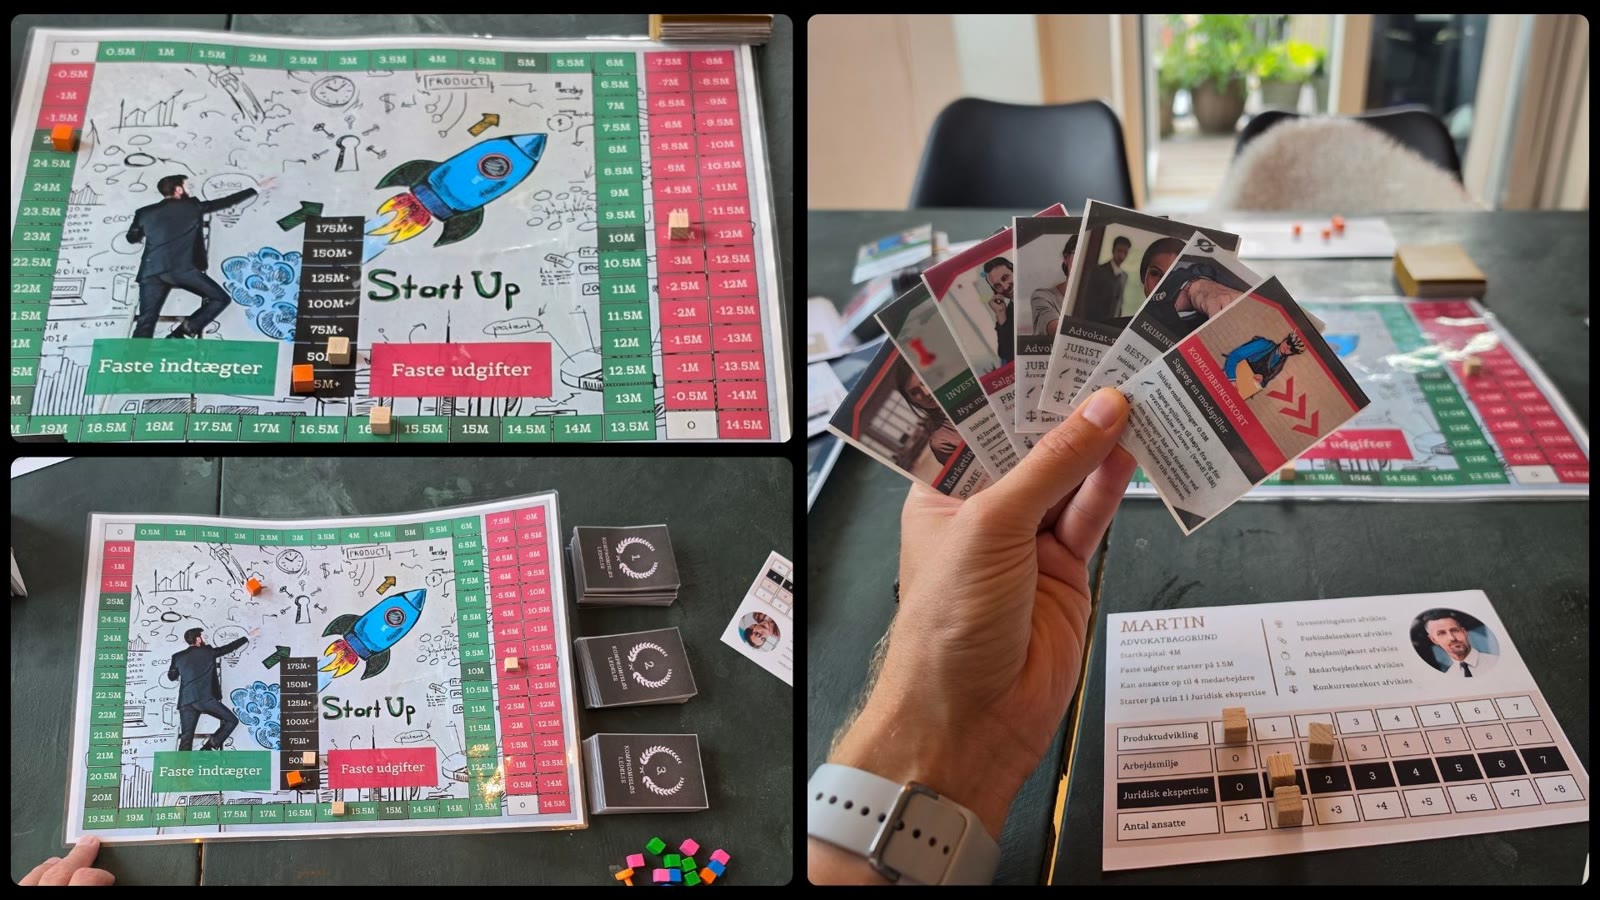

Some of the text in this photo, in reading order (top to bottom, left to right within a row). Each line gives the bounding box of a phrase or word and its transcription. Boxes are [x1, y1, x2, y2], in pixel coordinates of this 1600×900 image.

[106, 48, 135, 57] 0.5M
[158, 48, 174, 57] 1M
[199, 50, 225, 60] 1.5M
[290, 56, 317, 65] 2.5M
[468, 56, 496, 66] 4.5M
[518, 58, 535, 67] 5M
[557, 58, 584, 68] 5.5M
[54, 69, 88, 78] -0.5M
[428, 77, 485, 87] PRODUCT
[46, 113, 77, 122] -1.5M
[702, 118, 734, 127] -9.5M
[602, 123, 631, 132] 7.5M
[33, 159, 70, 168] 24.5M
[711, 182, 738, 192] -11M
[23, 207, 60, 216] 23.5M
[605, 210, 636, 220] 9.5M
[316, 225, 353, 233] 175M+
[715, 229, 742, 239] -12M
[608, 233, 635, 242] 10M
[313, 248, 352, 258] 150M+
[12, 257, 51, 267] 22.5M
[604, 258, 641, 268] 10.5M
[312, 273, 350, 283] 125M+
[13, 283, 41, 293] 22M
[368, 269, 463, 302] Start
[472, 272, 520, 310] Up
[666, 281, 699, 290] -2.5M
[716, 306, 754, 316] -12.5M
[311, 325, 344, 334] 75M+
[613, 338, 639, 348] 12M
[669, 335, 702, 344] -1.5M
[1064, 342, 1102, 359] JURIST
[99, 358, 262, 376] Faste indtægter
[719, 362, 760, 371] -13.5M
[1117, 355, 1136, 372] Initiale
[392, 362, 531, 382] Faste udgifter
[1187, 346, 1249, 428] KONKURRENCEKORT
[616, 393, 642, 403] 13M
[672, 391, 708, 400] -0.5M
[727, 390, 757, 400] -14M
[1170, 358, 1230, 435] Sagsøg en modspiller
[957, 402, 975, 417] Nye
[1156, 370, 1174, 391] Initiale
[1168, 389, 1200, 429] omkostninger
[1196, 426, 1210, 442] 0.5M
[88, 422, 126, 432] 18.5M
[194, 422, 232, 431] 17.5M
[300, 423, 338, 434] 16.5M
[462, 424, 489, 433] 15M
[565, 423, 591, 433] 14M
[611, 422, 649, 431] 13.5M
[1153, 388, 1222, 480] Sagsøg spilleren til højre fra dig for
[958, 469, 983, 498] SOME
[1120, 616, 1205, 632] MARTIN
[1120, 634, 1217, 646] ADVOKATBAGGRUND
[1120, 650, 1167, 659] Startkapital:
[1143, 664, 1175, 673] udgifter
[1309, 662, 1404, 675] Medarbejderkort afvikles
[1202, 674, 1255, 684] medarbejdere
[1313, 678, 1412, 691] Konkurrencekort afvikles
[1225, 689, 1266, 699] ekspertise
[322, 696, 415, 725] Start Up
[1123, 730, 1198, 742] Produktudvikling
[341, 763, 425, 777] Faste udgifter
[624, 745, 635, 794] KOMPROMISLØS
[1123, 760, 1178, 770] Arbejdsmiljø
[160, 765, 262, 779] Faste indtægter
[1123, 787, 1208, 800] Juridisk ekspertise
[1123, 819, 1186, 831] Antal ansatte
